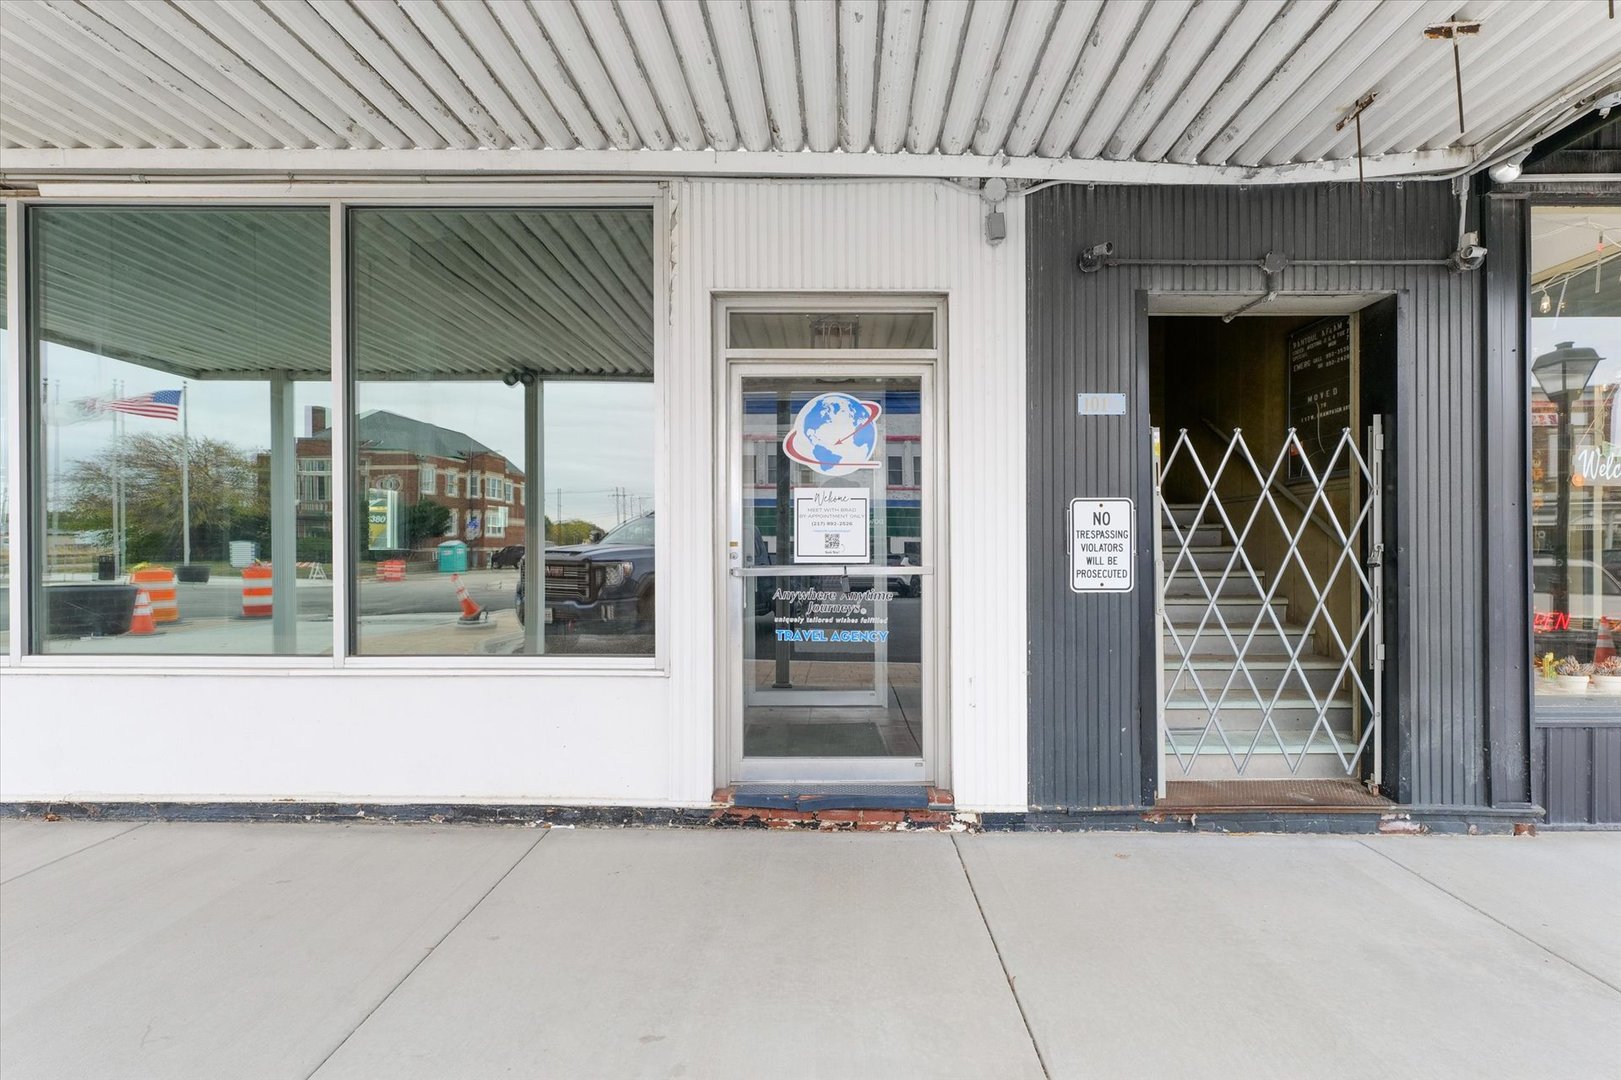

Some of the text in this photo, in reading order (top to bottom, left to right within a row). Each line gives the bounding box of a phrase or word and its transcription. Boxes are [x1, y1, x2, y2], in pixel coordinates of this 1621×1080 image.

[1092, 511, 1111, 526] NO
[1075, 529, 1129, 540] TRESPASSING
[1080, 543, 1124, 553] VIOLATORS
[1085, 556, 1118, 566] WILL BE
[1076, 569, 1128, 579] PROSECUTED
[772, 587, 894, 604] Anywhere Anytime
[774, 616, 805, 624] uniquely
[806, 616, 834, 624] tailored
[835, 616, 859, 624] wishes
[1533, 611, 1570, 631] PEN
[775, 629, 890, 643] TRAVEL AGENCY
